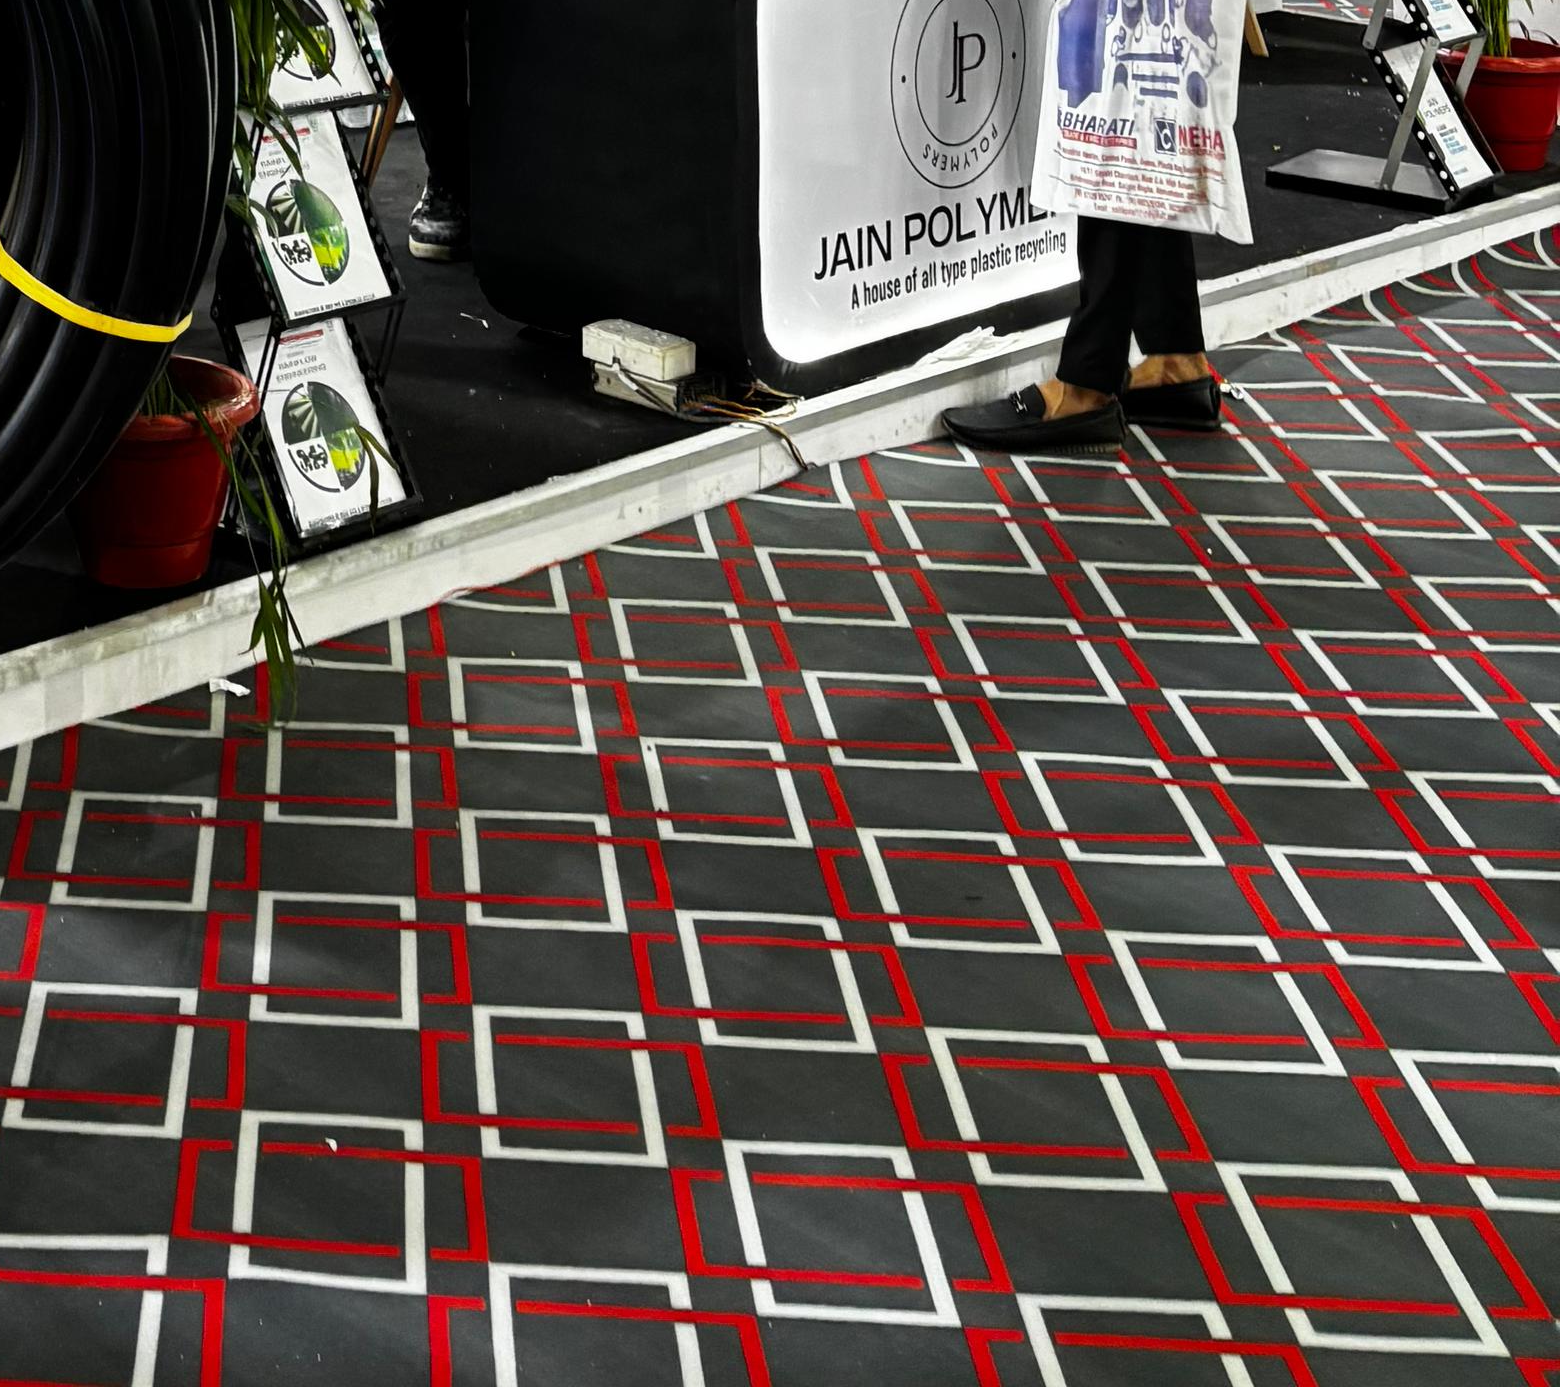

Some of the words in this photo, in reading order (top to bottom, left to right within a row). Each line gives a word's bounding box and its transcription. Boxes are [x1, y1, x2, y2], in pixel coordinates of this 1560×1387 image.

[923, 123, 998, 172] POLYMERS
[1063, 111, 1136, 136] BHARATI
[1178, 125, 1224, 150] NEHA
[814, 219, 892, 280] JAIN
[851, 283, 860, 310] A
[863, 277, 901, 307] house
[905, 266, 918, 294] of
[922, 261, 937, 288] all
[941, 258, 967, 288] type
[970, 244, 1012, 281] plastic
[1015, 230, 1067, 265] recycling
